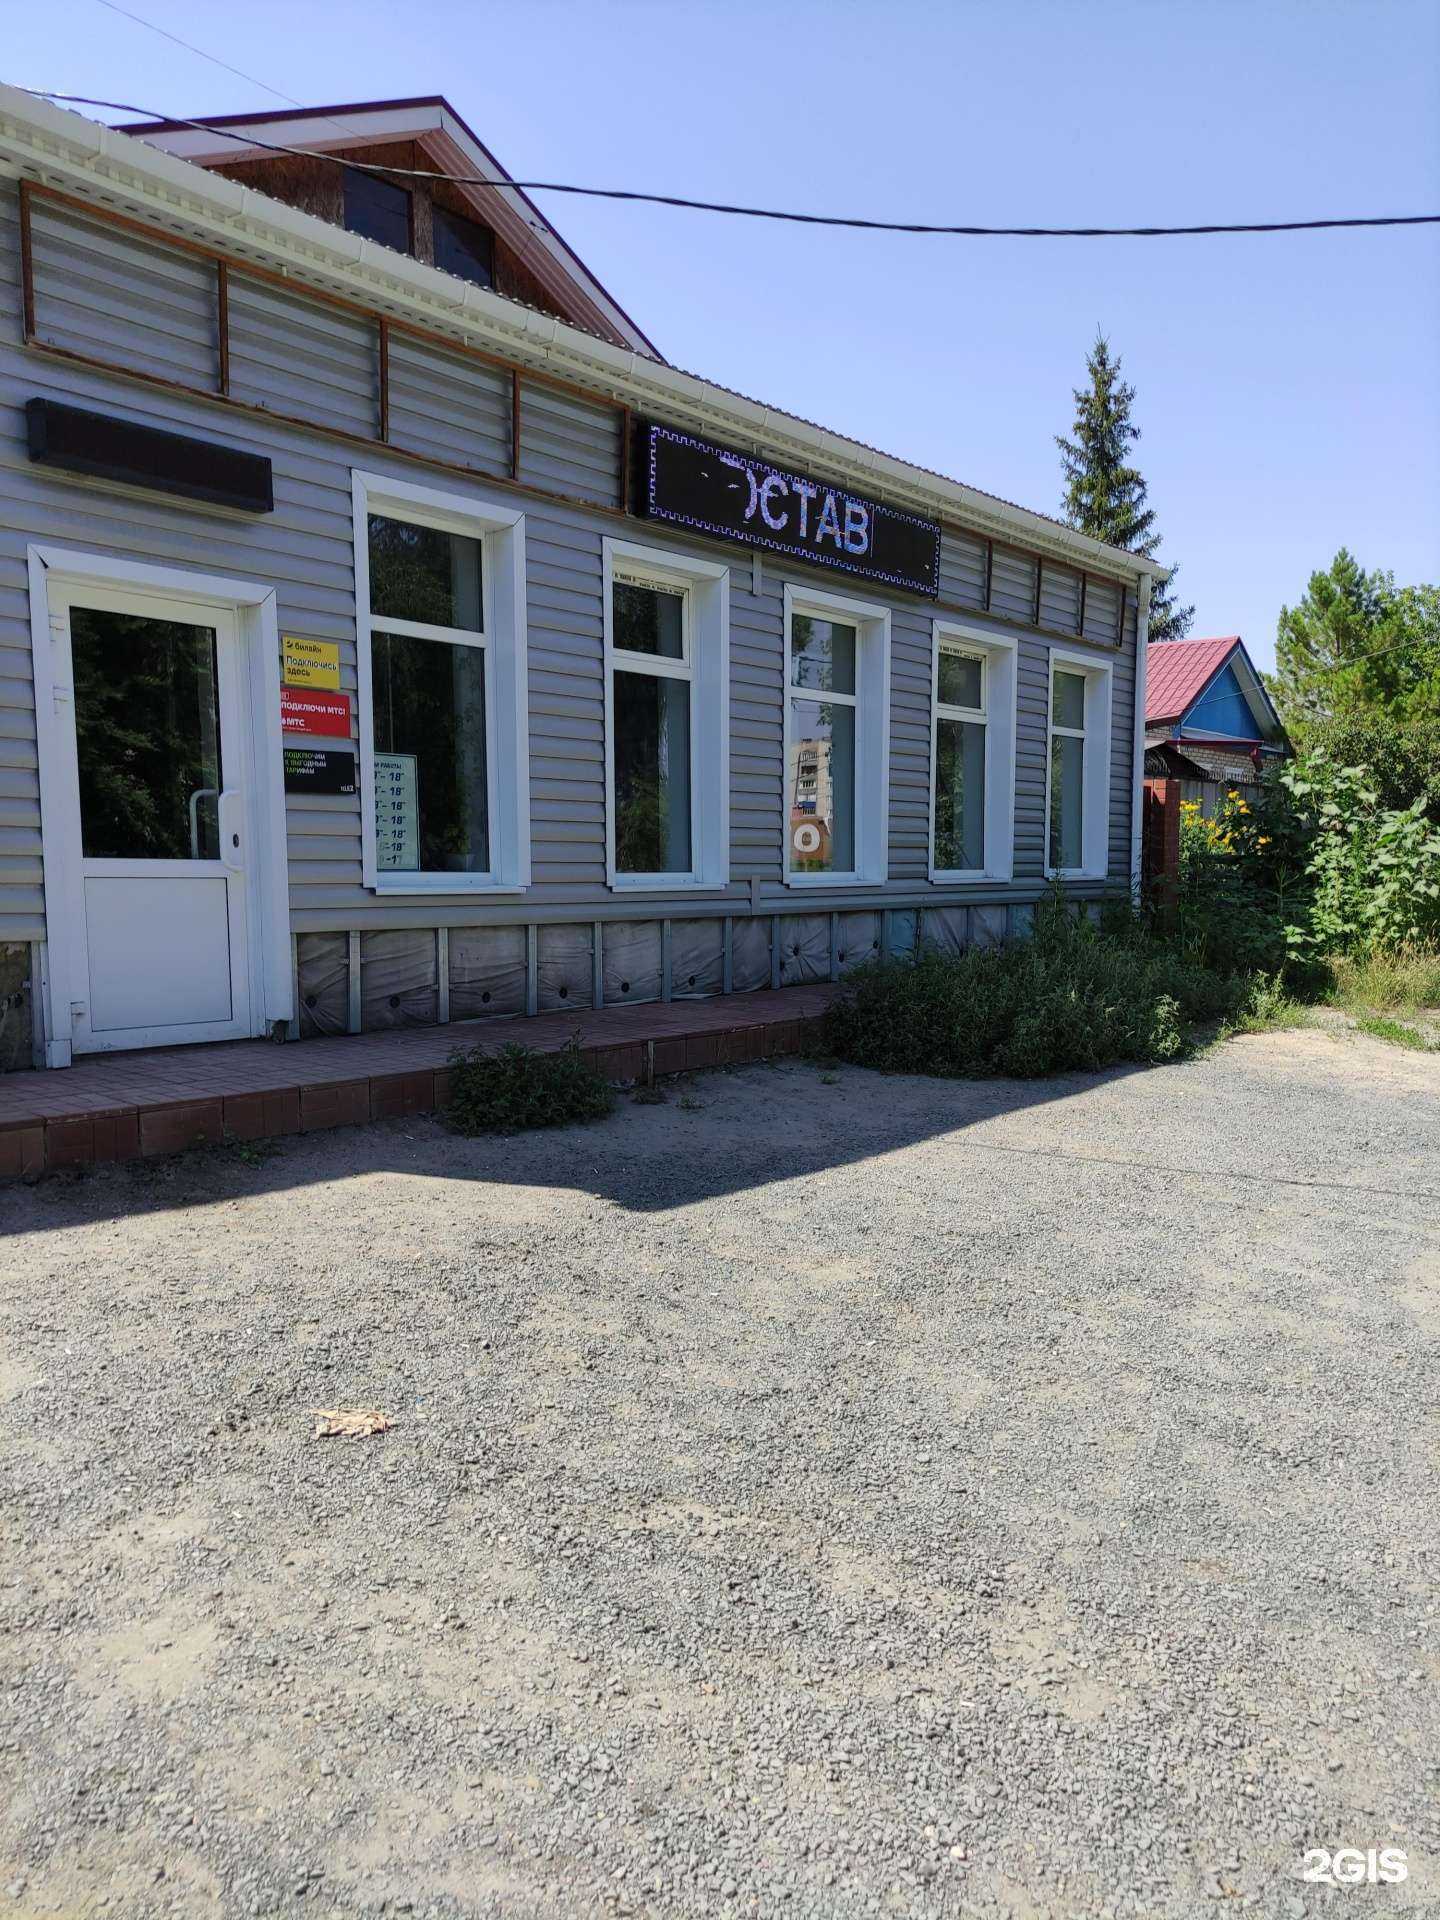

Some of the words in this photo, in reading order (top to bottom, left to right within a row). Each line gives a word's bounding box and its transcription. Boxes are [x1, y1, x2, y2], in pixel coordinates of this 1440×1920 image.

[294, 641, 322, 653] билайн
[286, 655, 337, 671] Подключись
[281, 701, 326, 713] ПОДКЛЮЧИ
[286, 717, 305, 727] МТС
